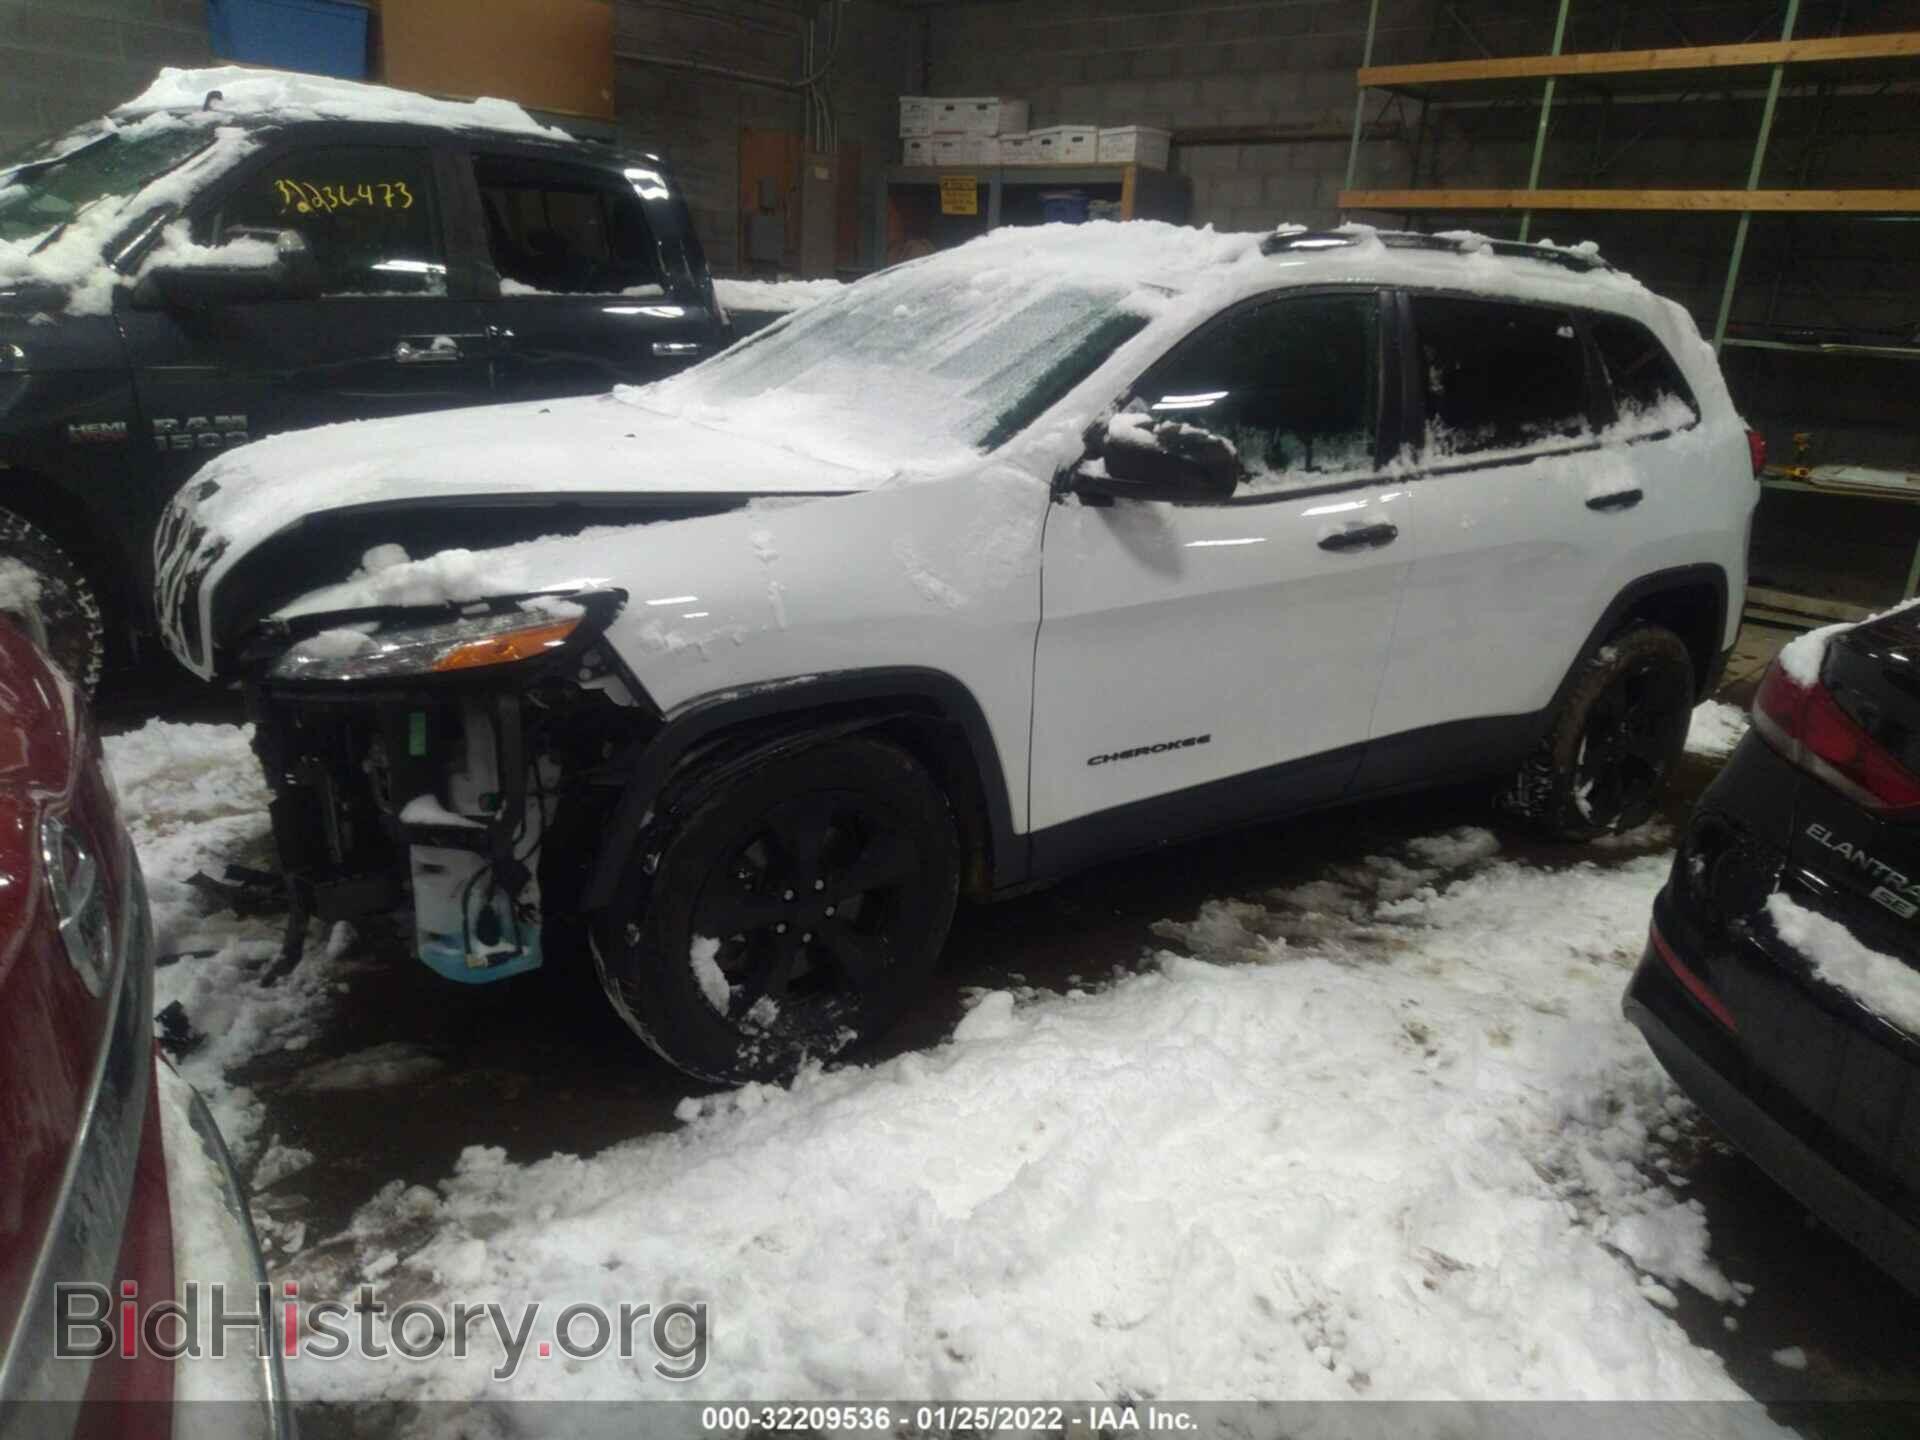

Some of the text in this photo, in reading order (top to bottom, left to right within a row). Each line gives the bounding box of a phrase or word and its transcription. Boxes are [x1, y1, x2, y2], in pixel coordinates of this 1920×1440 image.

[275, 179, 414, 214] 32236473
[68, 421, 127, 433] HEMI
[152, 415, 248, 432] RAM
[153, 432, 248, 449] 1500
[1087, 734, 1212, 766] CHEROKEE
